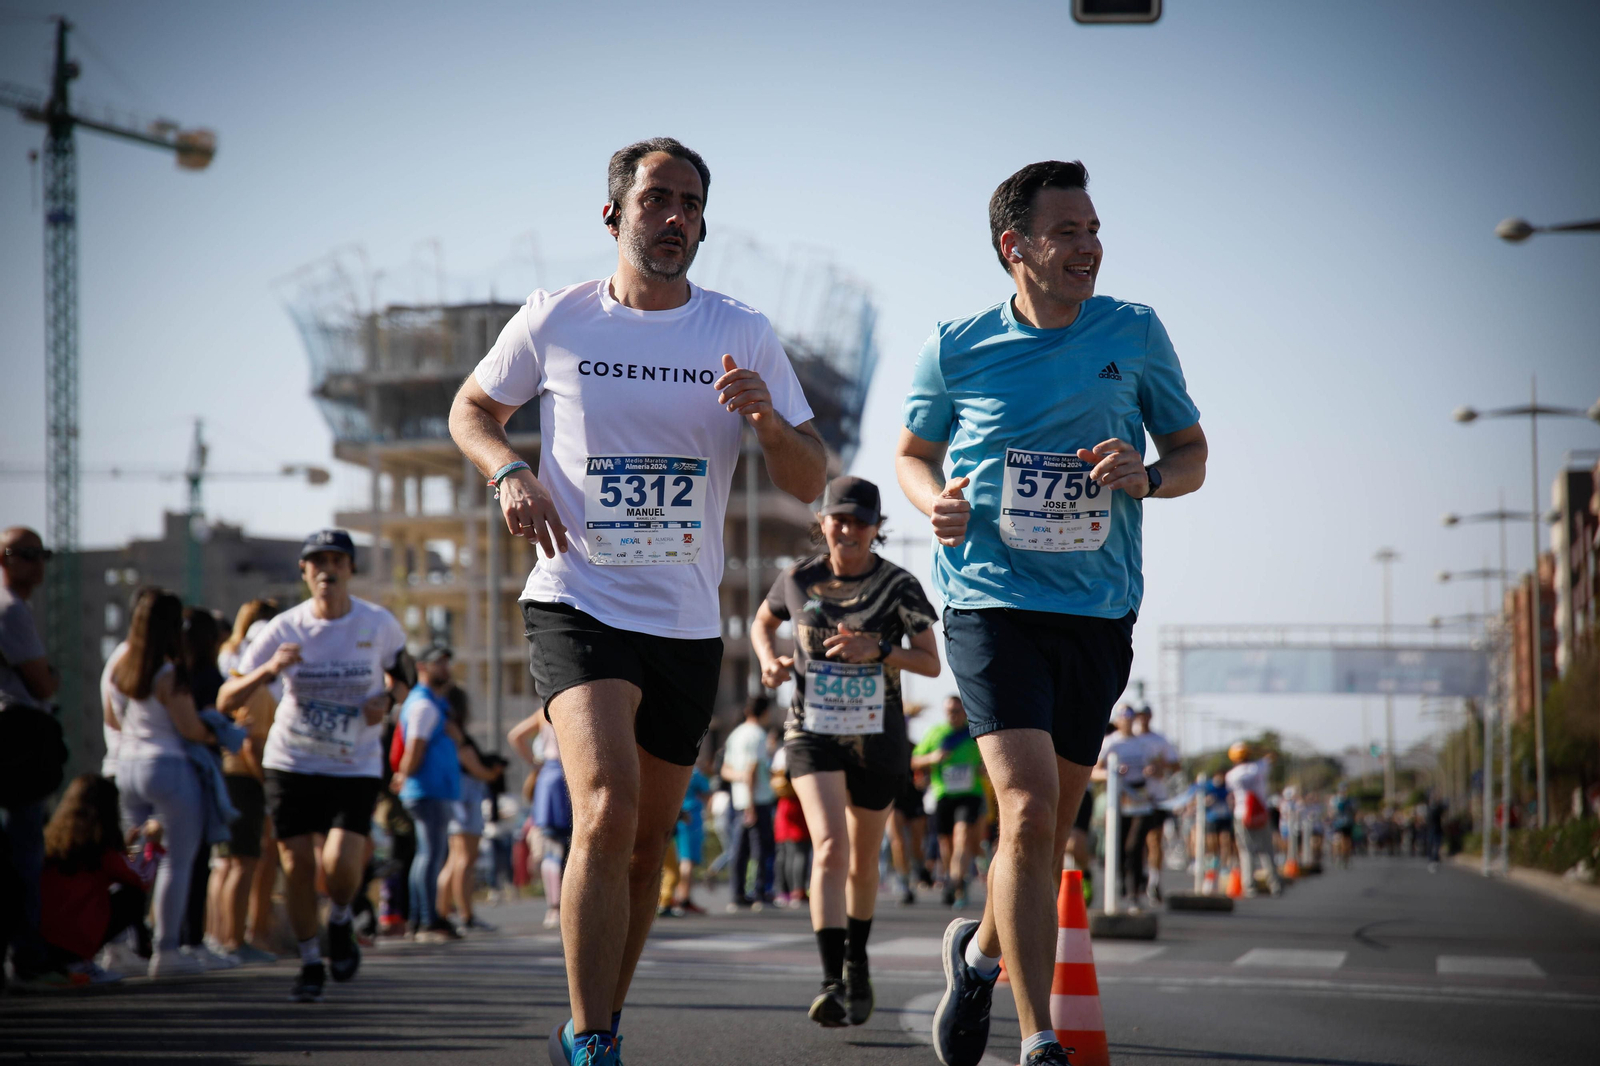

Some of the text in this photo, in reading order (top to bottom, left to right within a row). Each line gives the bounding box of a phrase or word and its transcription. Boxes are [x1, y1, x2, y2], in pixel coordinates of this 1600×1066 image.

[578, 360, 714, 384] COSENTINO
[1098, 372, 1122, 381] adidas
[1043, 460, 1066, 468] Almería
[1017, 469, 1101, 501] 5756
[599, 475, 694, 507] 5312
[1043, 500, 1067, 509] JOSE
[626, 508, 665, 517] MANUEL
[1032, 526, 1052, 534] NEXAL
[620, 537, 641, 545] NEXAL
[814, 676, 876, 698] 5469
